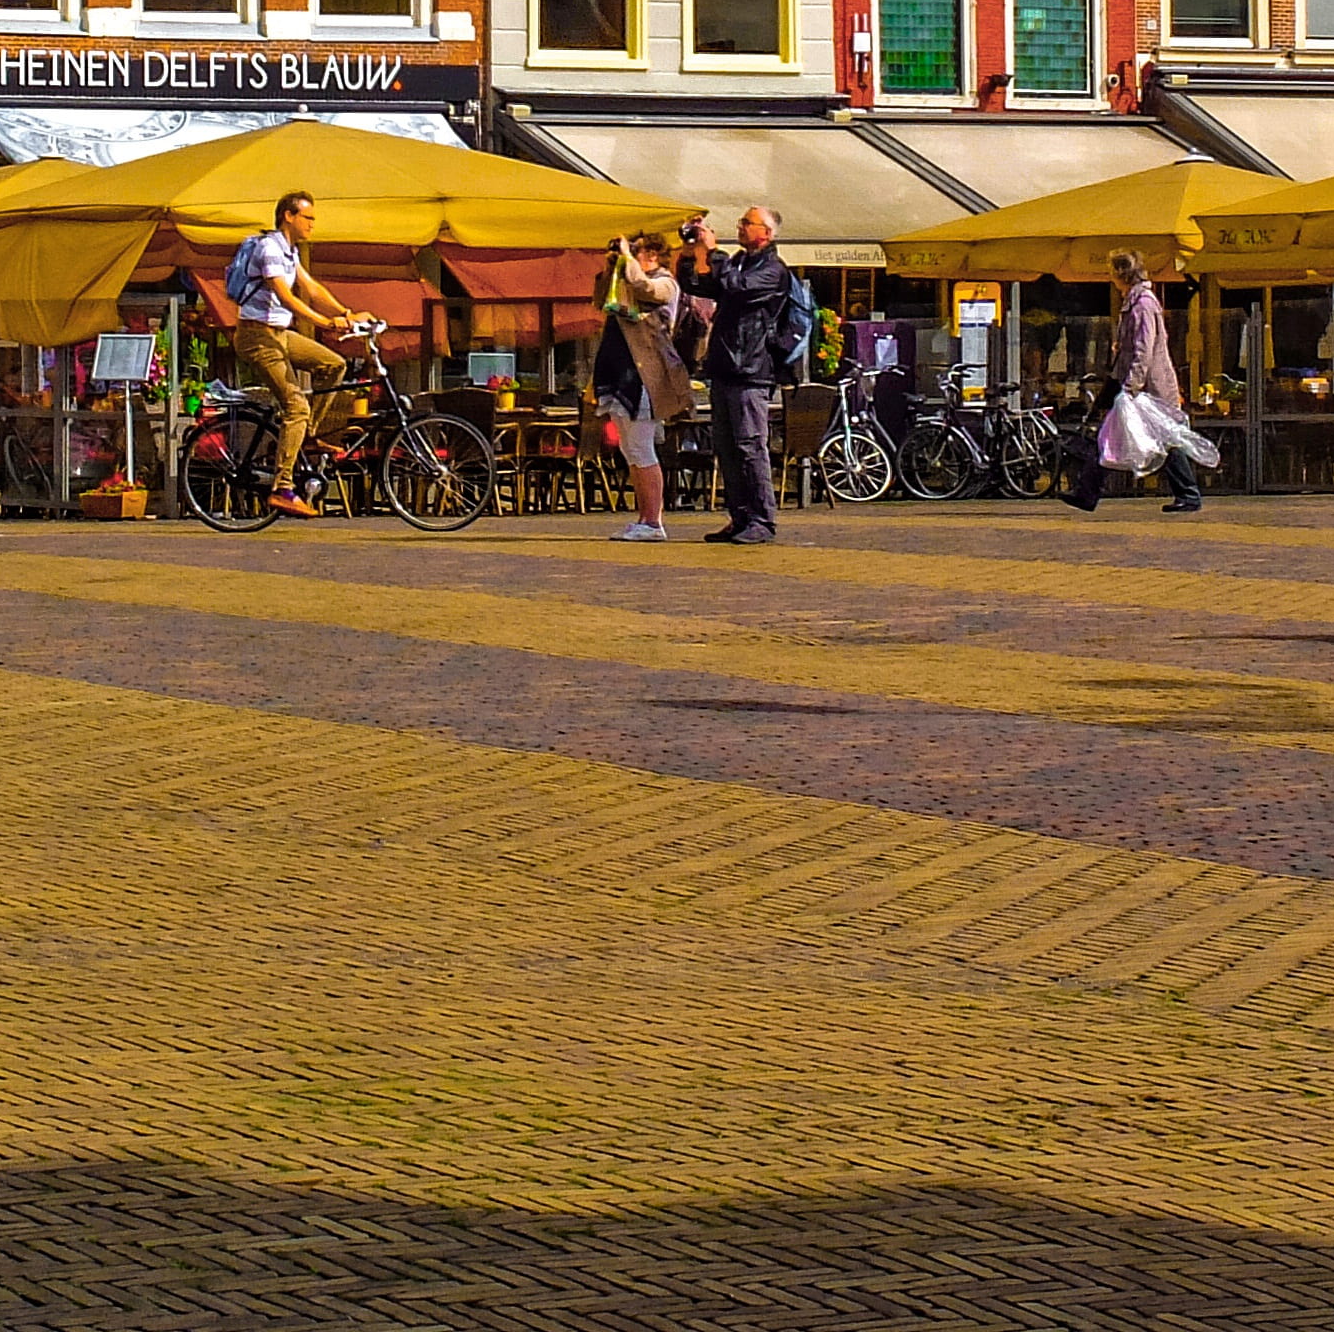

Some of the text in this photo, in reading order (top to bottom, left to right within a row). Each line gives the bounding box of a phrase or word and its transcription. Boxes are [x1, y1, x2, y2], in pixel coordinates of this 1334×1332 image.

[0, 49, 129, 88] HEINEN
[143, 51, 268, 90] DELFTS
[835, 250, 870, 264] gulden
